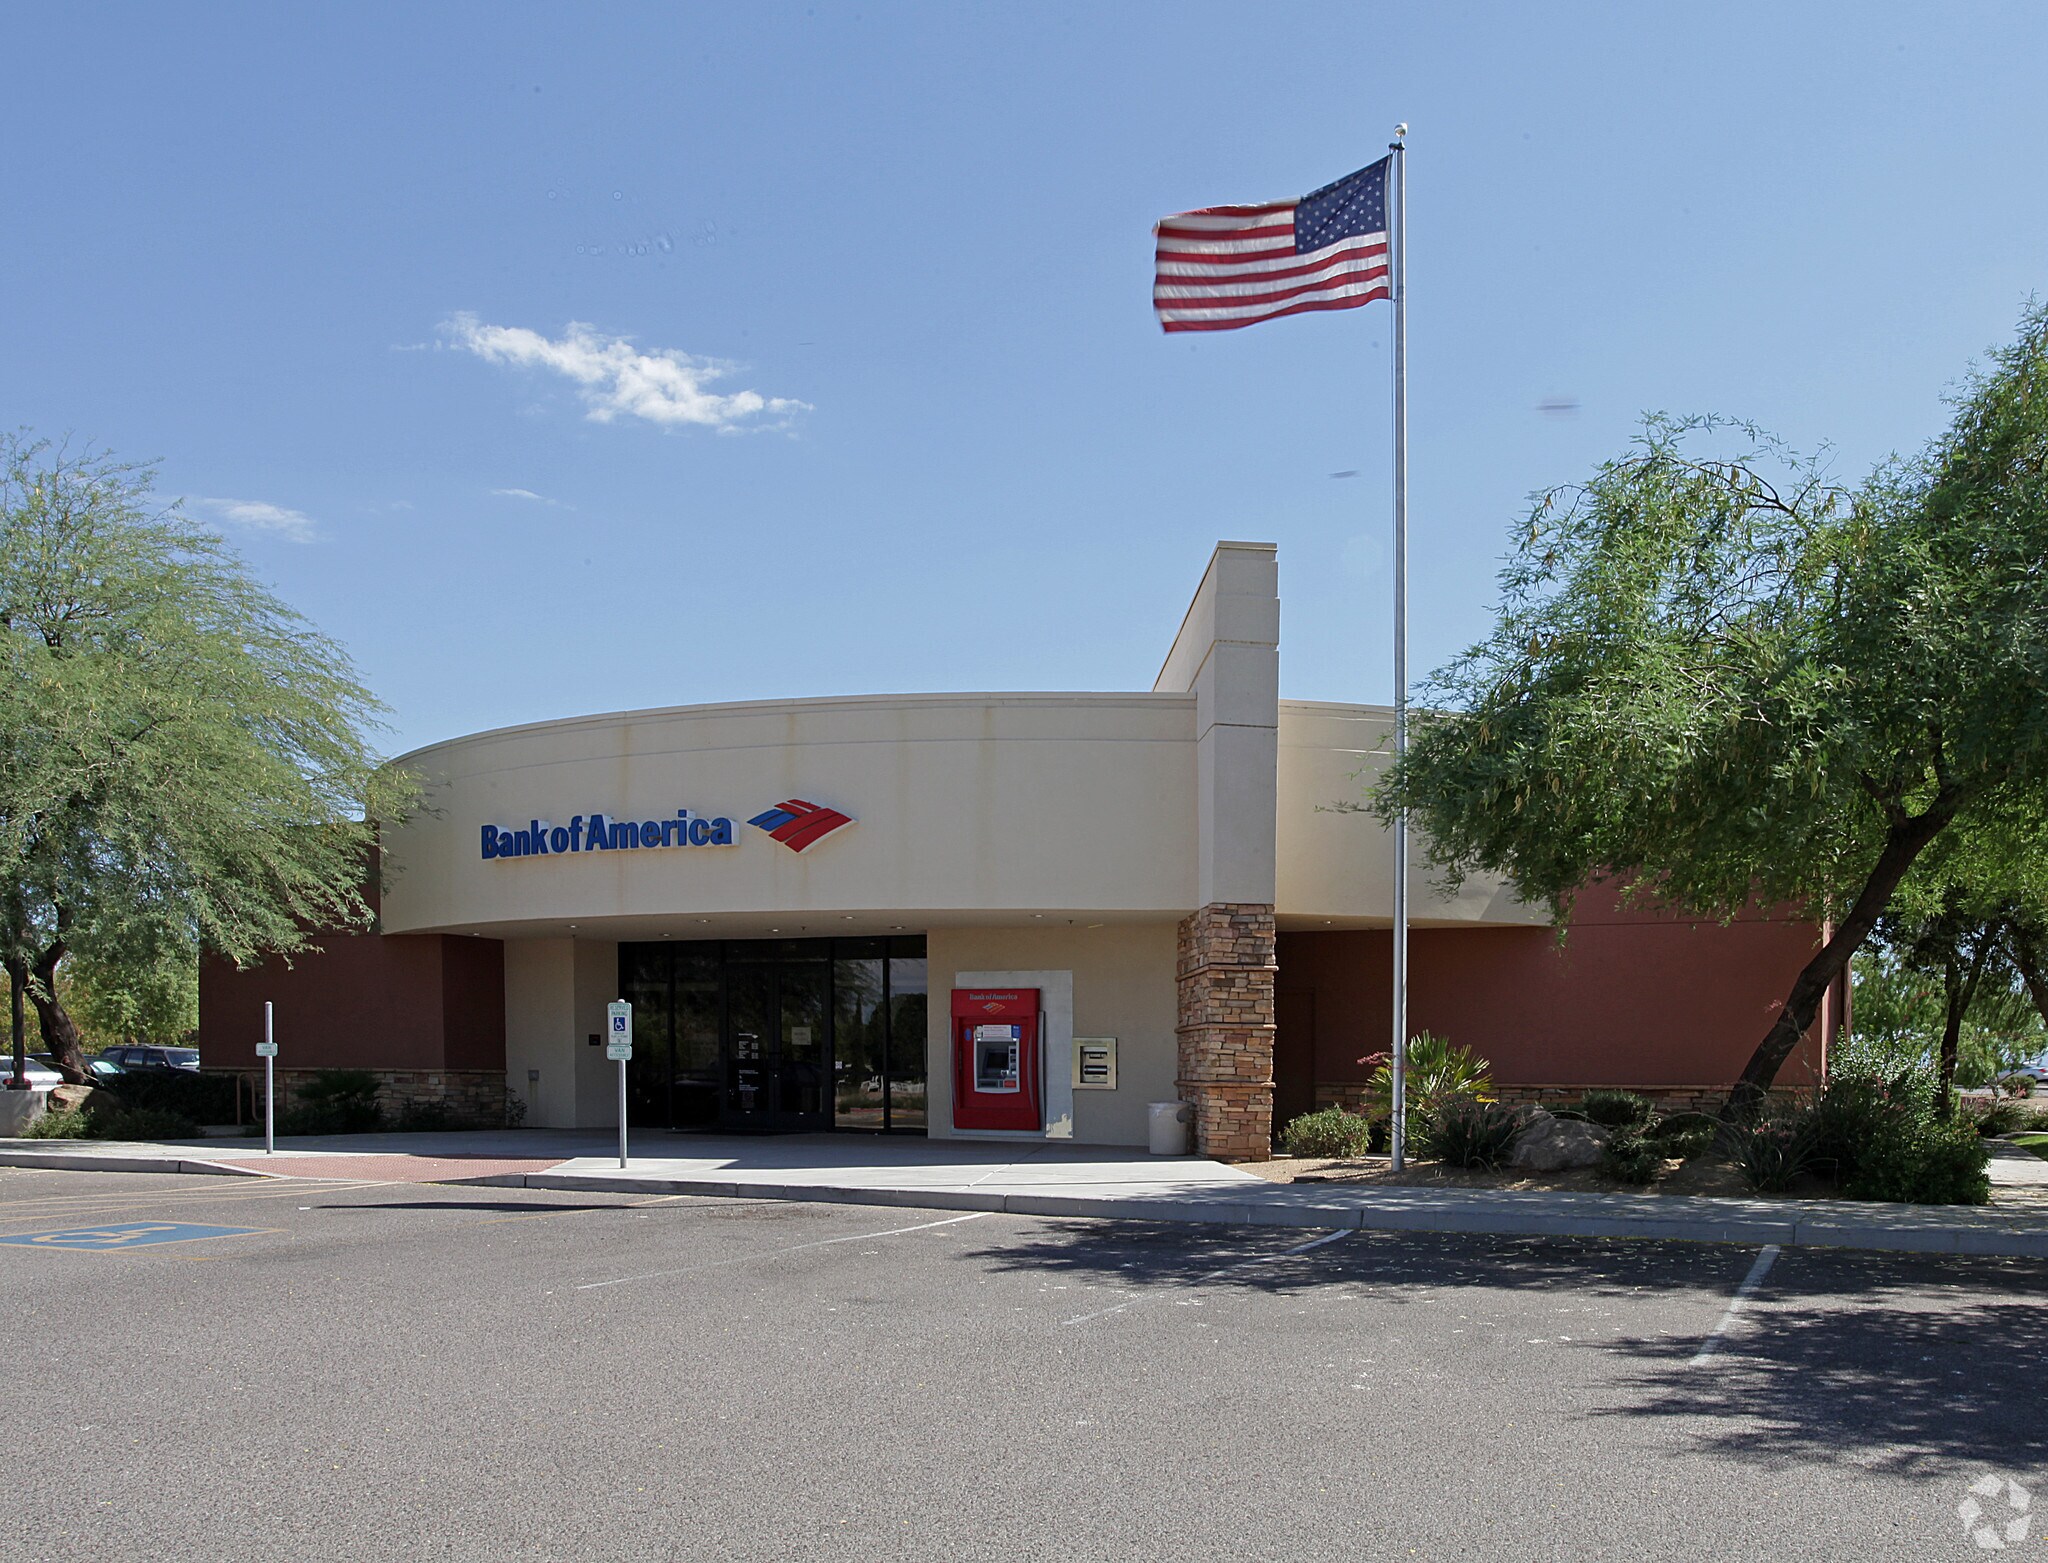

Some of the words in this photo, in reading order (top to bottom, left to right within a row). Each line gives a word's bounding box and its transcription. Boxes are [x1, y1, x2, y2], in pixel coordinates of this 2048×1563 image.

[481, 819, 550, 860] Bank
[550, 815, 583, 854] of
[584, 808, 734, 852] America
